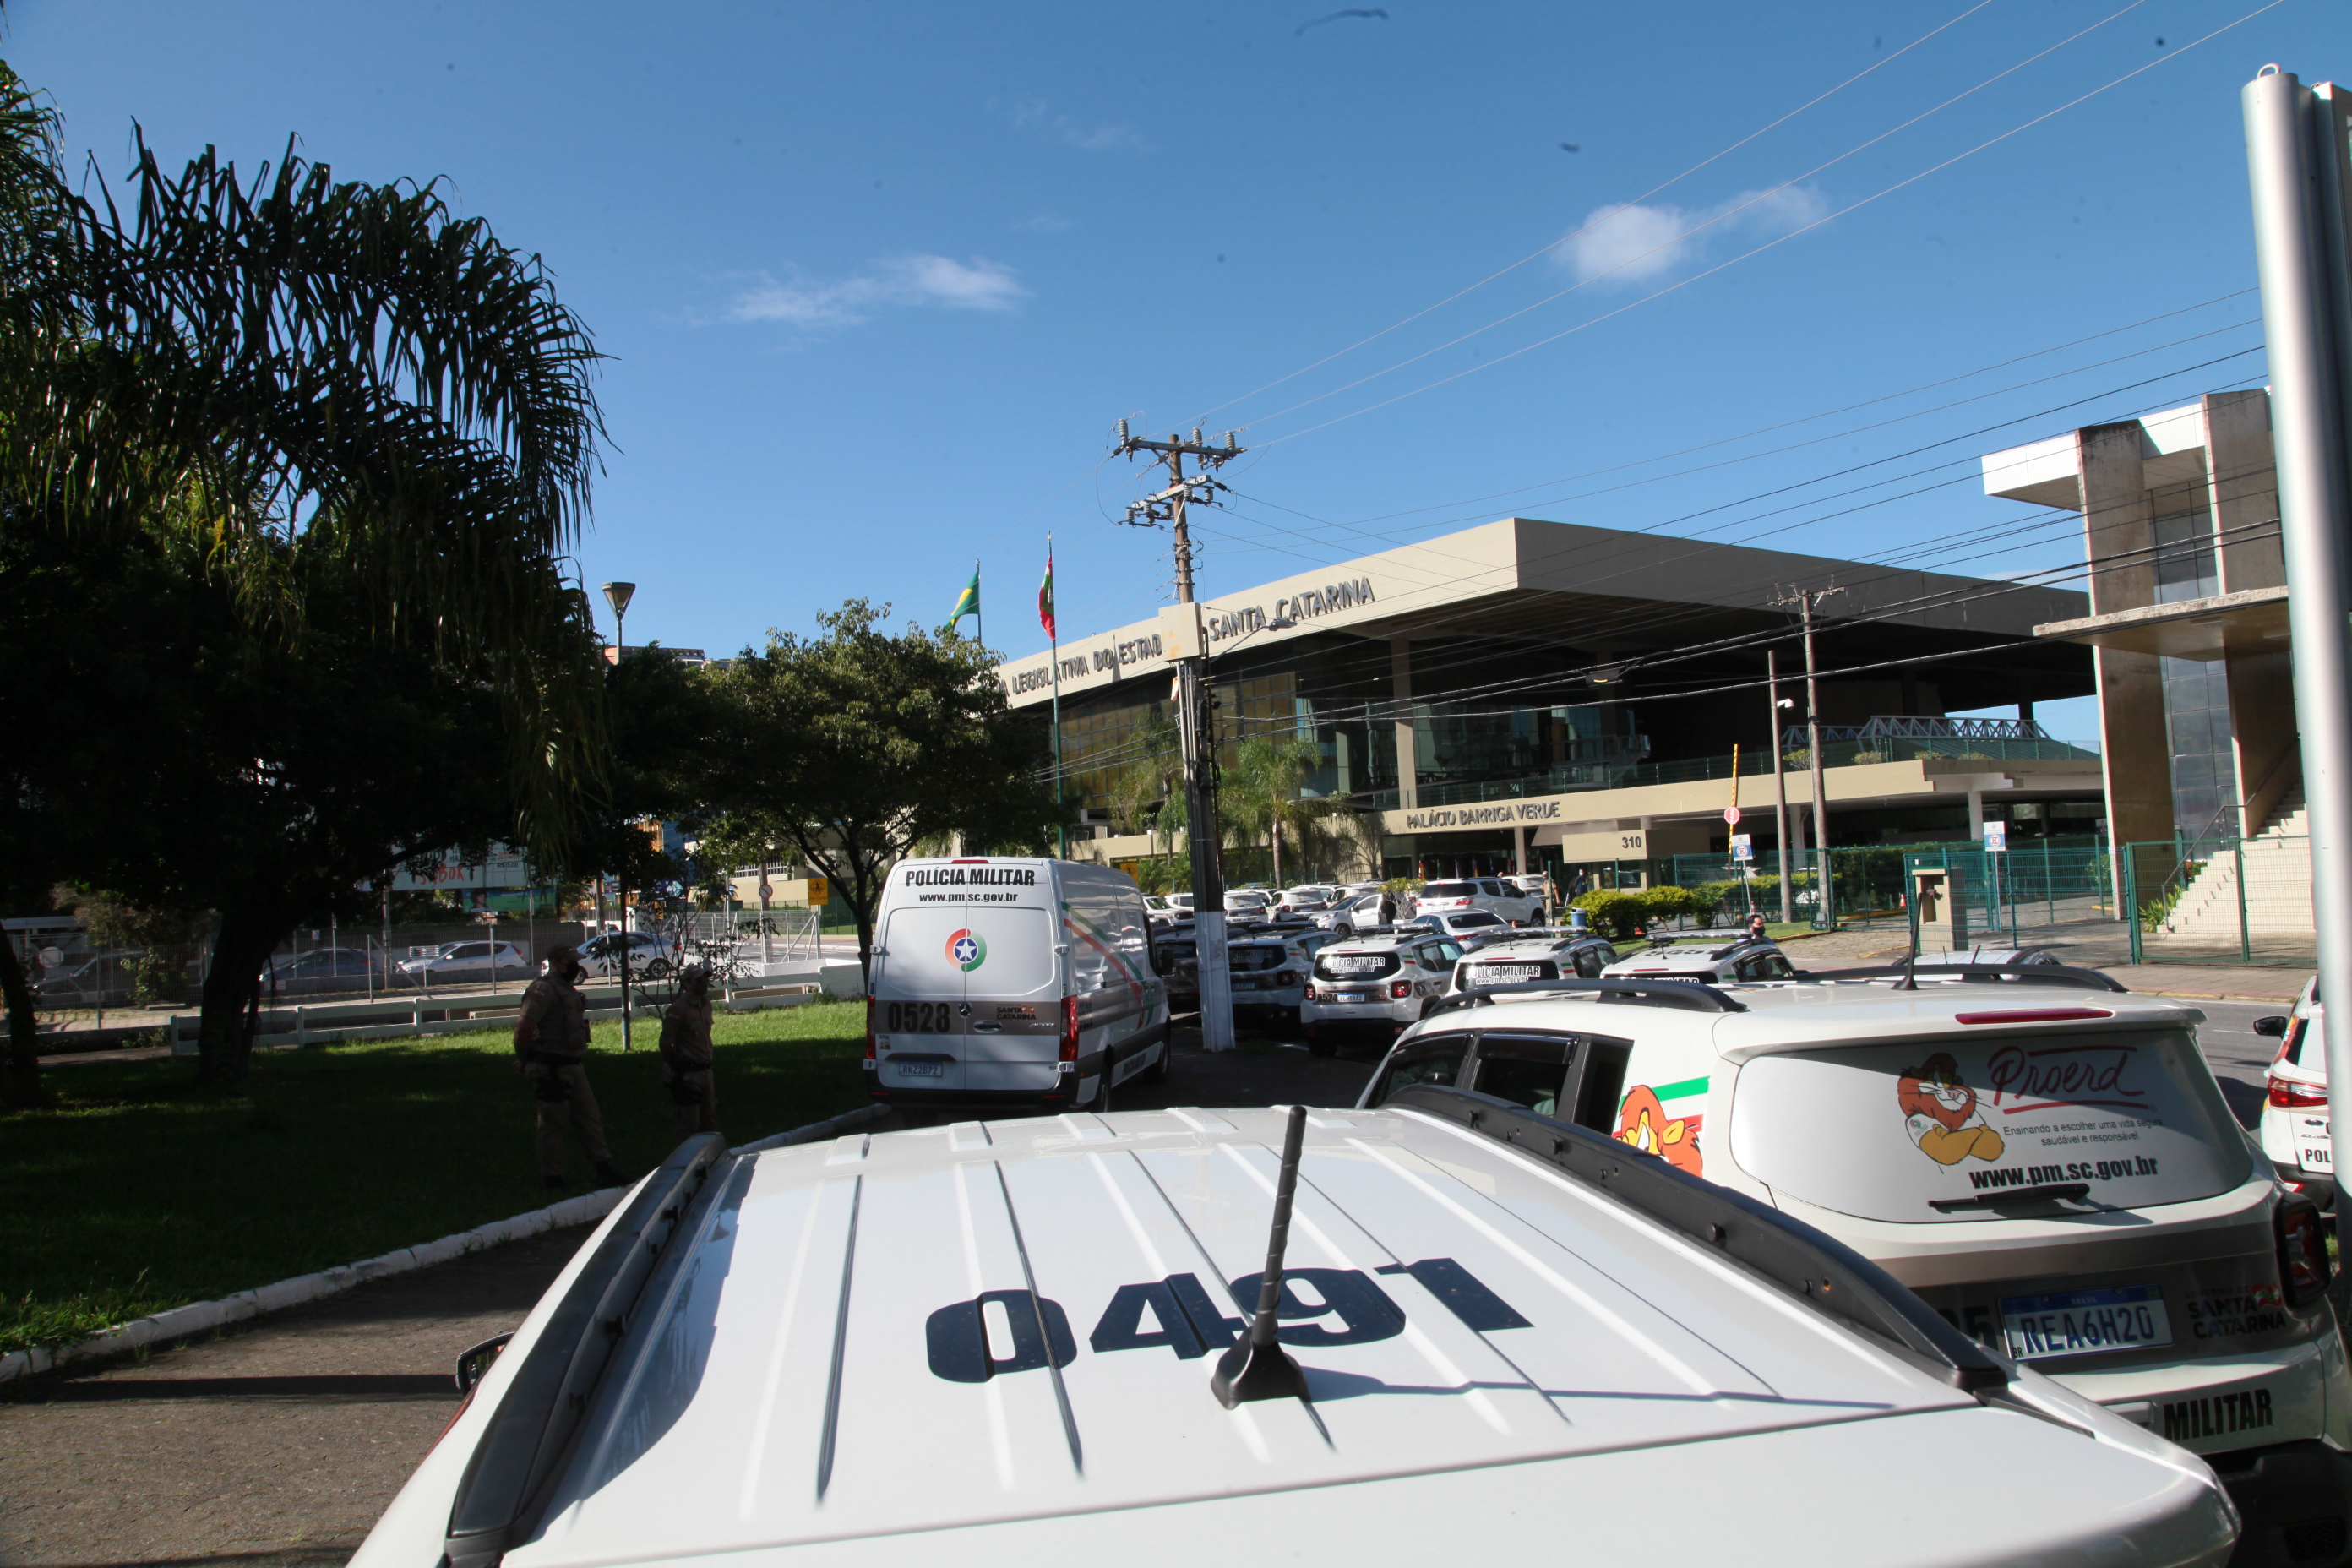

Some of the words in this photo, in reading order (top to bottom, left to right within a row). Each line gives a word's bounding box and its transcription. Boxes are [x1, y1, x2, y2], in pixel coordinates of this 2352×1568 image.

[1093, 648, 1114, 672] DO
[1119, 634, 1162, 665] ESTAD
[1209, 605, 1267, 642] SANTA
[1276, 576, 1376, 623] CATARINA
[1407, 809, 1456, 830] PALÁCIO
[1459, 805, 1515, 825] BARRIGA
[1515, 801, 1561, 820] VERDE
[1622, 836, 1642, 849] 310
[906, 866, 966, 887] POLÍCIA
[968, 868, 1036, 887] MILITAR
[919, 892, 1019, 903] www.pm.sc.gov.br
[1353, 956, 1386, 967] MILITAR
[1466, 964, 1500, 979] POLÍCIA
[1501, 965, 1541, 977] MILITAR
[1317, 993, 1337, 1003] 0524
[888, 1003, 950, 1032] 0528
[1987, 1046, 2146, 1108] Proerd
[2003, 1124, 2051, 1136] Ensinando
[2061, 1121, 2097, 1132] escolher
[2099, 1120, 2117, 1130] uma
[2118, 1118, 2136, 1129] vida
[2041, 1134, 2081, 1146] saudável
[2090, 1131, 2142, 1145] responsável.
[2305, 1148, 2332, 1163] POL
[1968, 1156, 2159, 1189] www.pm.sc.gov.br
[2071, 1294, 2098, 1305] BRASIL
[2188, 1295, 2258, 1319] SANTA
[926, 1257, 1535, 1383] 0491
[2020, 1305, 2156, 1354] REA6H20
[2193, 1311, 2286, 1339] CATARINA
[2012, 1347, 2024, 1358] BR
[2164, 1388, 2273, 1441] MILITAR
